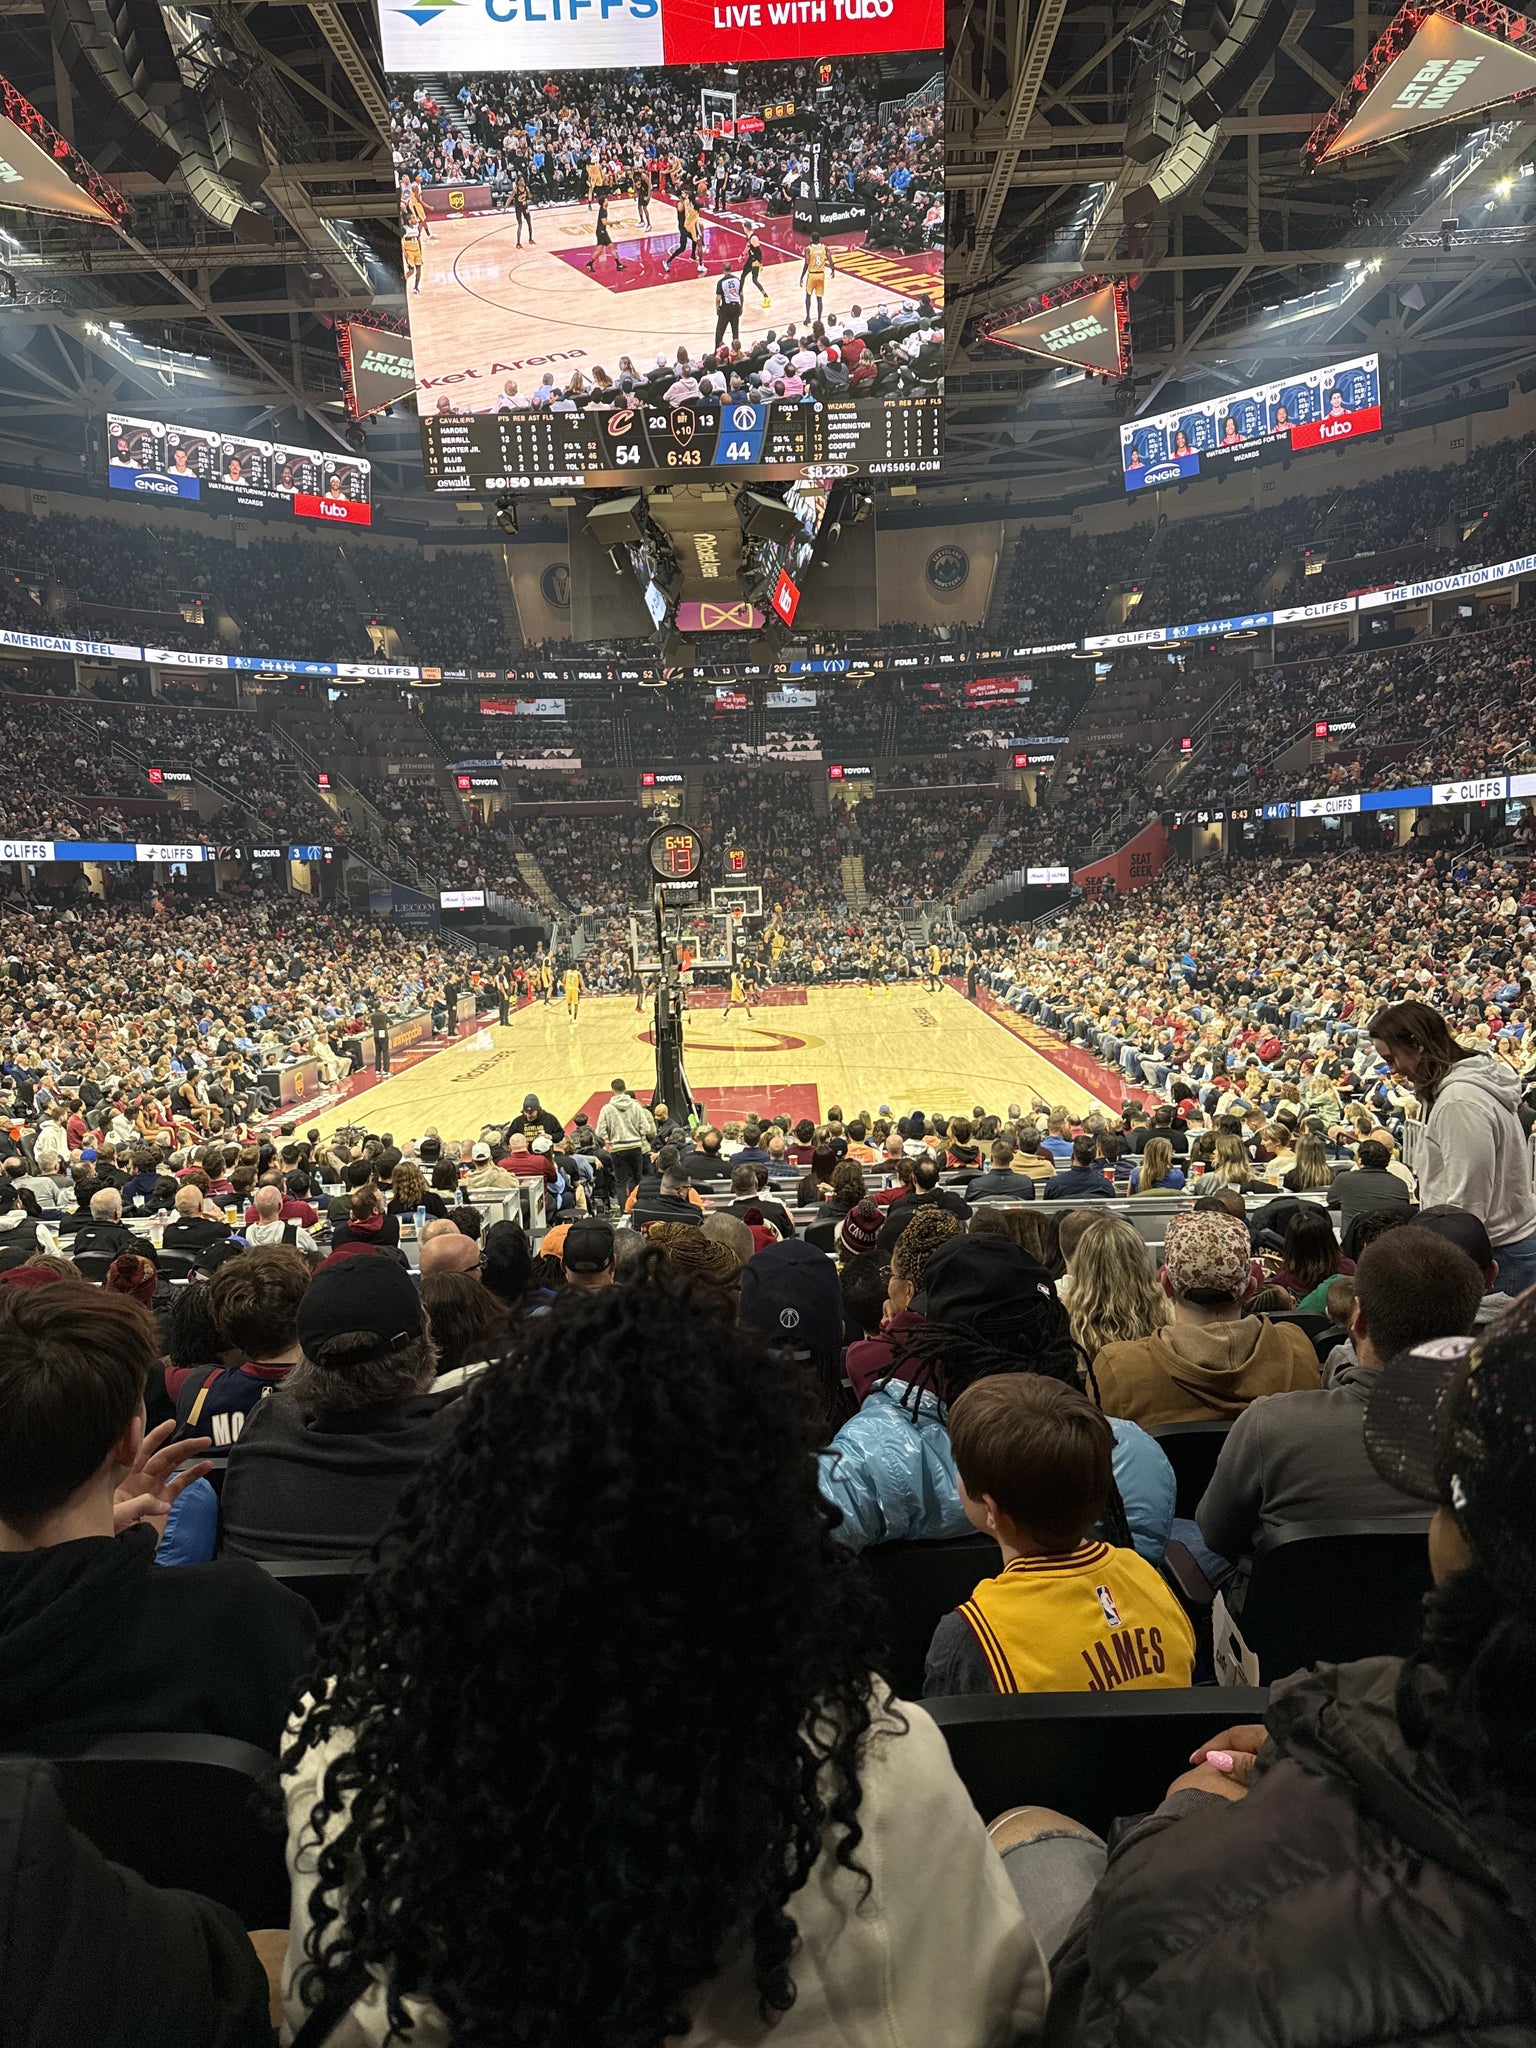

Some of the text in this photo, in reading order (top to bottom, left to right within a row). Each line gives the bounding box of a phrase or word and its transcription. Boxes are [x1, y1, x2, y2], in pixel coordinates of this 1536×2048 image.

[485, 0, 659, 22] CLIFFS
[714, 5, 761, 28] LIVE
[769, 0, 826, 24] WITH
[1391, 60, 1450, 108] LET EM
[1418, 56, 1486, 108] KNOW.
[820, 211, 850, 223] KeyBank
[1040, 315, 1098, 342] LET EM
[1047, 324, 1108, 352] KNOW.
[365, 350, 395, 364] LET
[491, 348, 587, 375] Arena
[649, 417, 667, 429] 2Q
[699, 416, 713, 426] 13
[828, 422, 870, 430] CARRINGTON
[676, 426, 691, 435] +10
[1320, 422, 1351, 439] fubo
[829, 442, 855, 450] COOPER
[1231, 436, 1262, 452] RETURNING
[1263, 435, 1275, 444] FOR
[1276, 432, 1288, 441] THE
[616, 445, 640, 464] 54
[726, 442, 750, 460] 44
[1234, 450, 1260, 462] WIZARDS
[667, 451, 701, 465] 6:43
[808, 466, 848, 479] $8,230
[869, 461, 940, 473] CAVS5050.COM
[438, 476, 470, 487] oswald
[534, 476, 585, 486] RAFFLE
[209, 483, 234, 492] WATKINS
[235, 486, 266, 497] RETURNING
[238, 498, 263, 506] WIZARDS
[320, 502, 347, 517] fubo
[1384, 563, 1504, 601] THE INNOVATION IN
[1305, 602, 1347, 616] CLIFFS
[1118, 631, 1160, 643] CLIFFS
[3, 632, 114, 656] AMERICAN STEEL
[1046, 642, 1077, 652] KNOW.
[178, 654, 223, 665] CLIFFS
[368, 667, 410, 676] CLIFFS
[693, 668, 704, 676] 54
[774, 665, 787, 673] 2Q
[1328, 722, 1356, 731] TOYOTA
[1461, 782, 1500, 799] CLIFFS
[1326, 800, 1352, 812] CLIFFS
[1198, 812, 1208, 822] 54
[1232, 810, 1247, 819] 6:43
[1268, 807, 1276, 816] 44
[666, 836, 692, 849] 6:43
[4, 844, 46, 858] CLIFFS
[161, 848, 193, 859] CLIFFS
[235, 848, 240, 858] 3
[294, 849, 299, 858] 3
[671, 850, 690, 871] 13
[733, 858, 743, 869] 13
[1131, 853, 1152, 864] SEAT
[1130, 866, 1152, 878] GEEK
[668, 881, 699, 889] TISSOT
[395, 903, 435, 912] LECOM
[393, 1024, 422, 1048] unstoppable
[1081, 1627, 1165, 1691] JAMES
